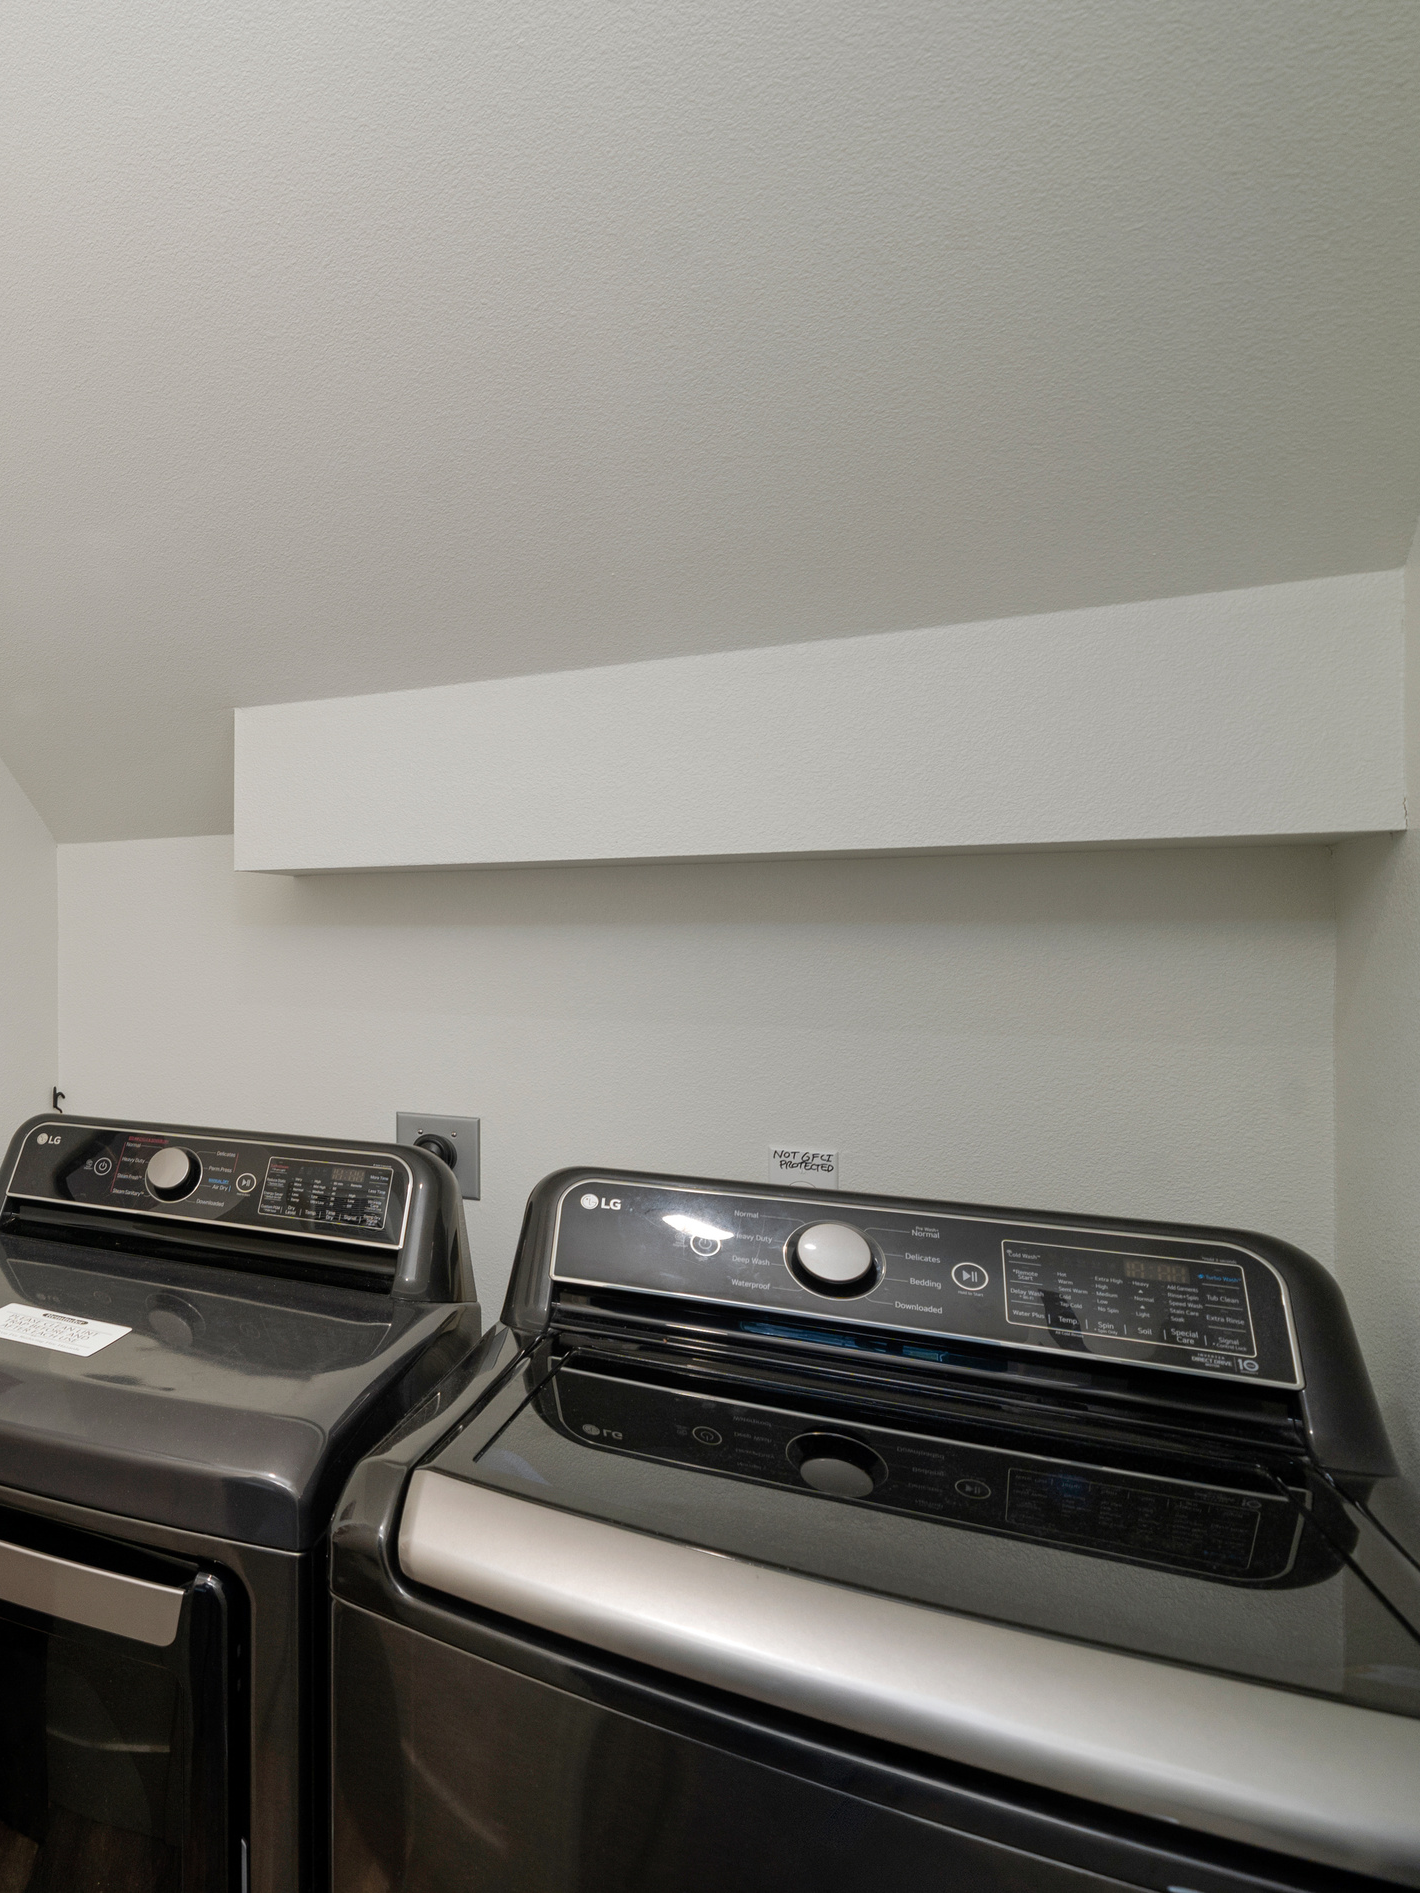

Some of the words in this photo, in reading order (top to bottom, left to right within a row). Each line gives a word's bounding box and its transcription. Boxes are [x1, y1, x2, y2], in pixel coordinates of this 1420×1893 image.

[48, 1135, 62, 1145] LG
[216, 1150, 236, 1158] Delicates
[773, 1149, 800, 1160] NOT
[800, 1151, 834, 1163] GFCI
[779, 1159, 834, 1173] PROTECTED
[196, 1198, 225, 1207] Downloaded
[600, 1197, 622, 1211] LG
[734, 1209, 759, 1219] Normal
[755, 1233, 774, 1244] Duty
[911, 1229, 940, 1239] Normal
[732, 1255, 752, 1266] Deep
[753, 1257, 771, 1267] Wash
[905, 1252, 941, 1264] Delicates
[1057, 1278, 1074, 1286] Warm
[1094, 1275, 1110, 1283] Extra
[1109, 1277, 1124, 1285] High
[1205, 1274, 1222, 1282] Turbo
[731, 1278, 772, 1291] Waterproof
[909, 1277, 942, 1290] Bedding
[1131, 1280, 1150, 1289] Heavy
[1010, 1288, 1027, 1296] Delay
[1027, 1289, 1045, 1298] Wash
[1176, 1285, 1199, 1293] Garments
[1133, 1295, 1155, 1303] Normal
[1167, 1292, 1200, 1301] Rinse+Spin
[1219, 1296, 1240, 1304] Clean
[894, 1300, 943, 1315] Downloaded
[1168, 1300, 1187, 1308] Speed
[1186, 1301, 1204, 1309] Wash
[1012, 1309, 1031, 1317] Water
[1031, 1311, 1046, 1319] Plus
[1169, 1307, 1185, 1315] Stain
[1185, 1309, 1200, 1317] Care
[1206, 1314, 1225, 1323] Extra
[1225, 1317, 1245, 1325] Rinse
[1097, 1321, 1115, 1330] Spin
[69, 1330, 91, 1341] AND
[1137, 1327, 1153, 1336] Soil
[1170, 1328, 1199, 1339] Special
[1176, 1336, 1195, 1345] Care
[1218, 1336, 1240, 1346] Signal
[1191, 1355, 1213, 1364] DIRECT
[1213, 1358, 1232, 1367] DRIVE
[1237, 1358, 1259, 1372] 10
